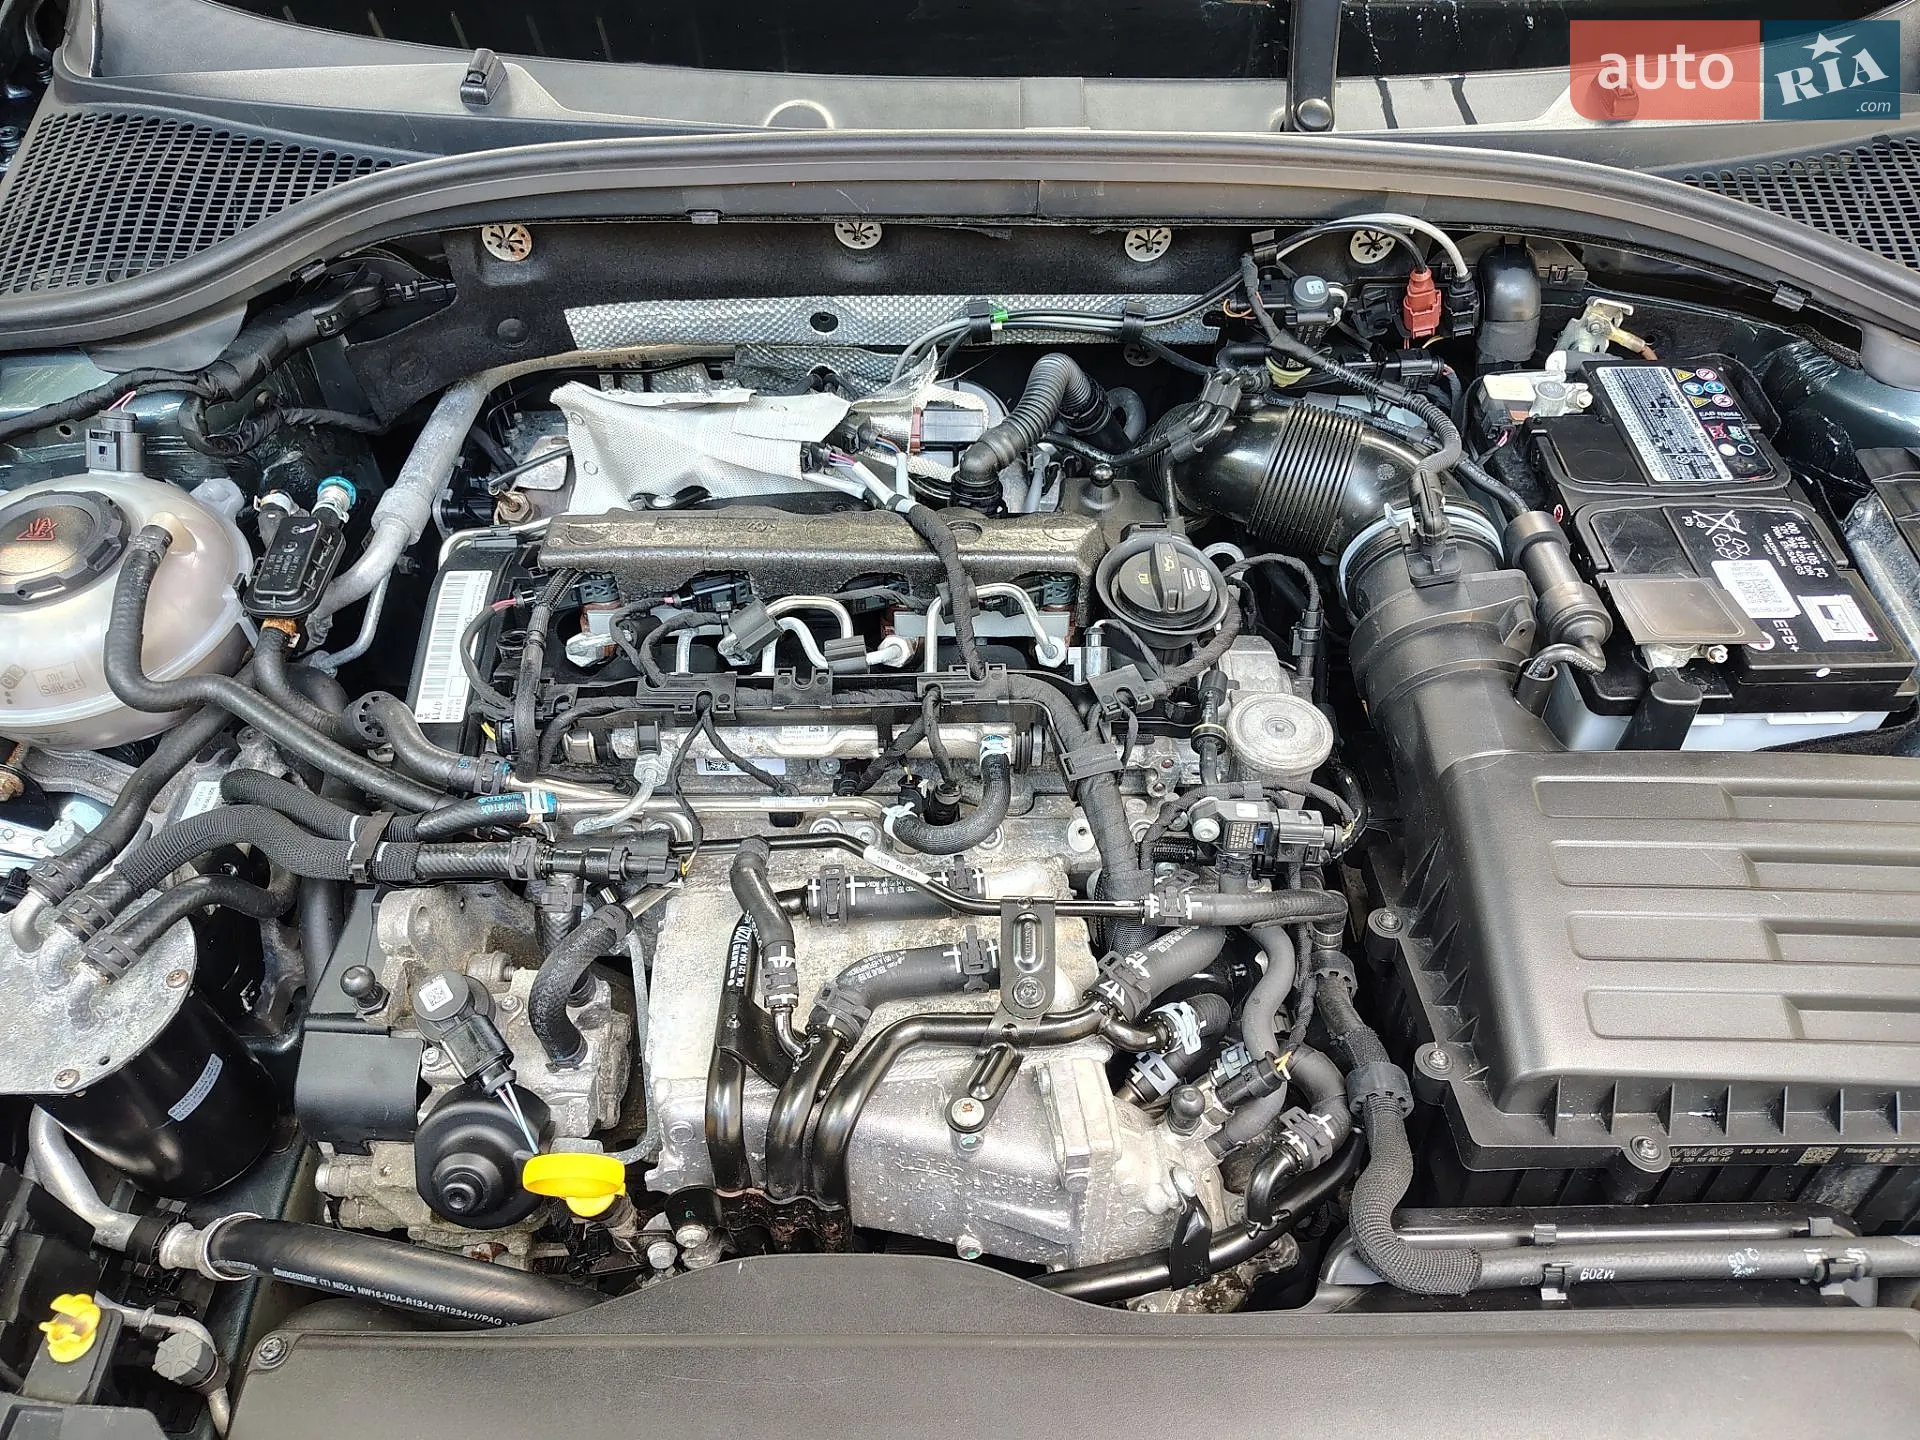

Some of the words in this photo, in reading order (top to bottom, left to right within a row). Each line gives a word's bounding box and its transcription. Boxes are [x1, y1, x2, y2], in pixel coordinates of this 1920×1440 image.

[1681, 515, 1695, 527] Pb
[1763, 533, 1788, 568] VOLKSWAGEN
[1795, 536, 1811, 550] 915
[1805, 552, 1821, 566] 105
[1813, 567, 1829, 579] FC
[1772, 619, 1800, 653] EFB+
[1672, 1147, 1705, 1158] VW
[1702, 1147, 1736, 1158] AG
[319, 1278, 332, 1288] (T)
